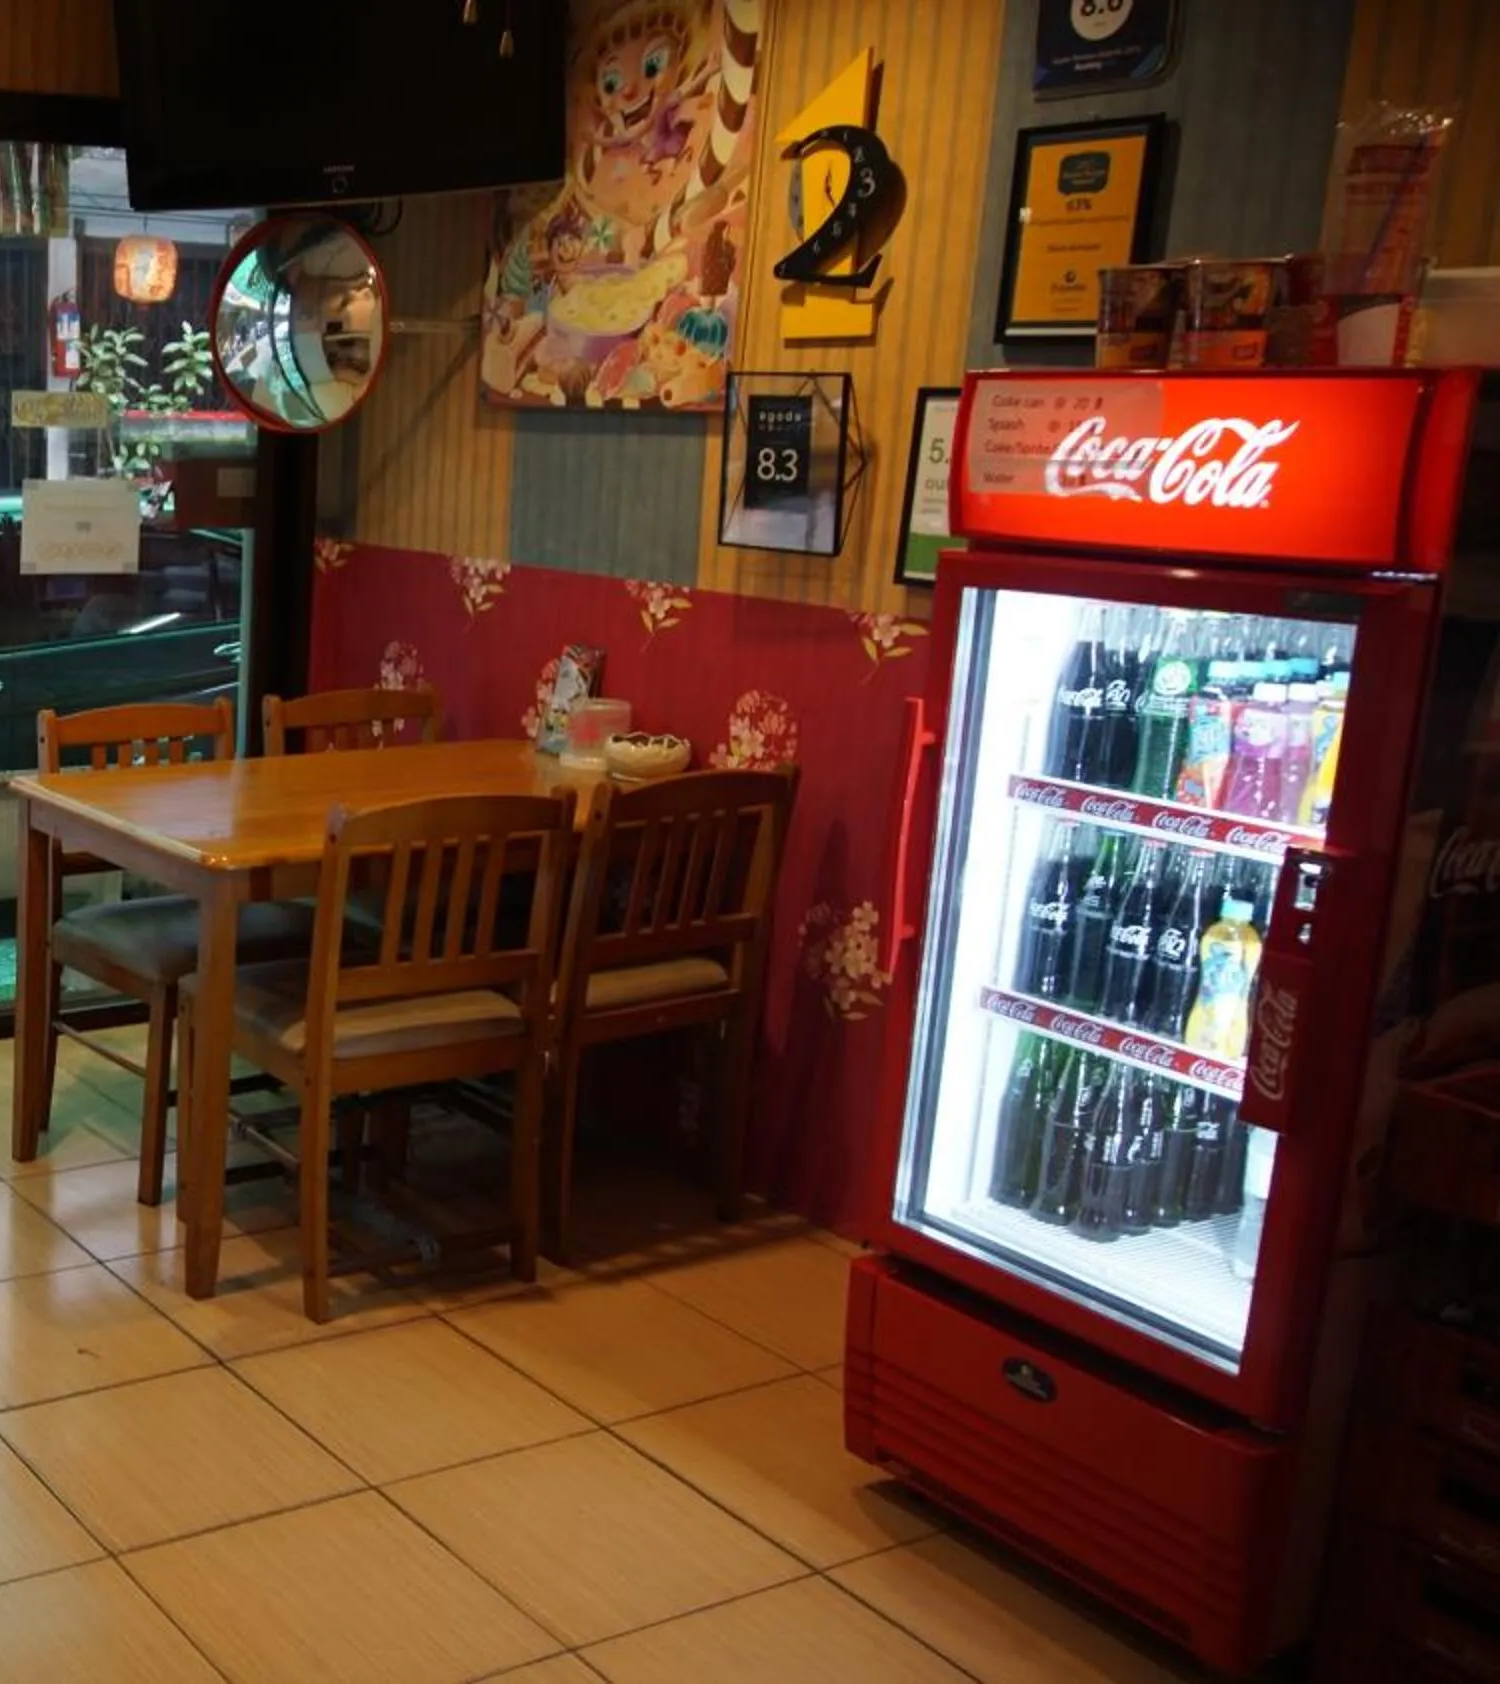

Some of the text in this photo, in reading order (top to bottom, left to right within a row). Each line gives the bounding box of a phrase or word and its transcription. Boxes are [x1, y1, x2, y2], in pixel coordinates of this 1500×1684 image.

[857, 167, 876, 198] 3
[757, 448, 798, 481] 8.3
[1045, 415, 1301, 508] Coca-Cola
[1080, 796, 1137, 823] Coca-Cola
[1152, 811, 1213, 839] Coca-Cola
[1119, 1035, 1175, 1068] Coca-Cola
